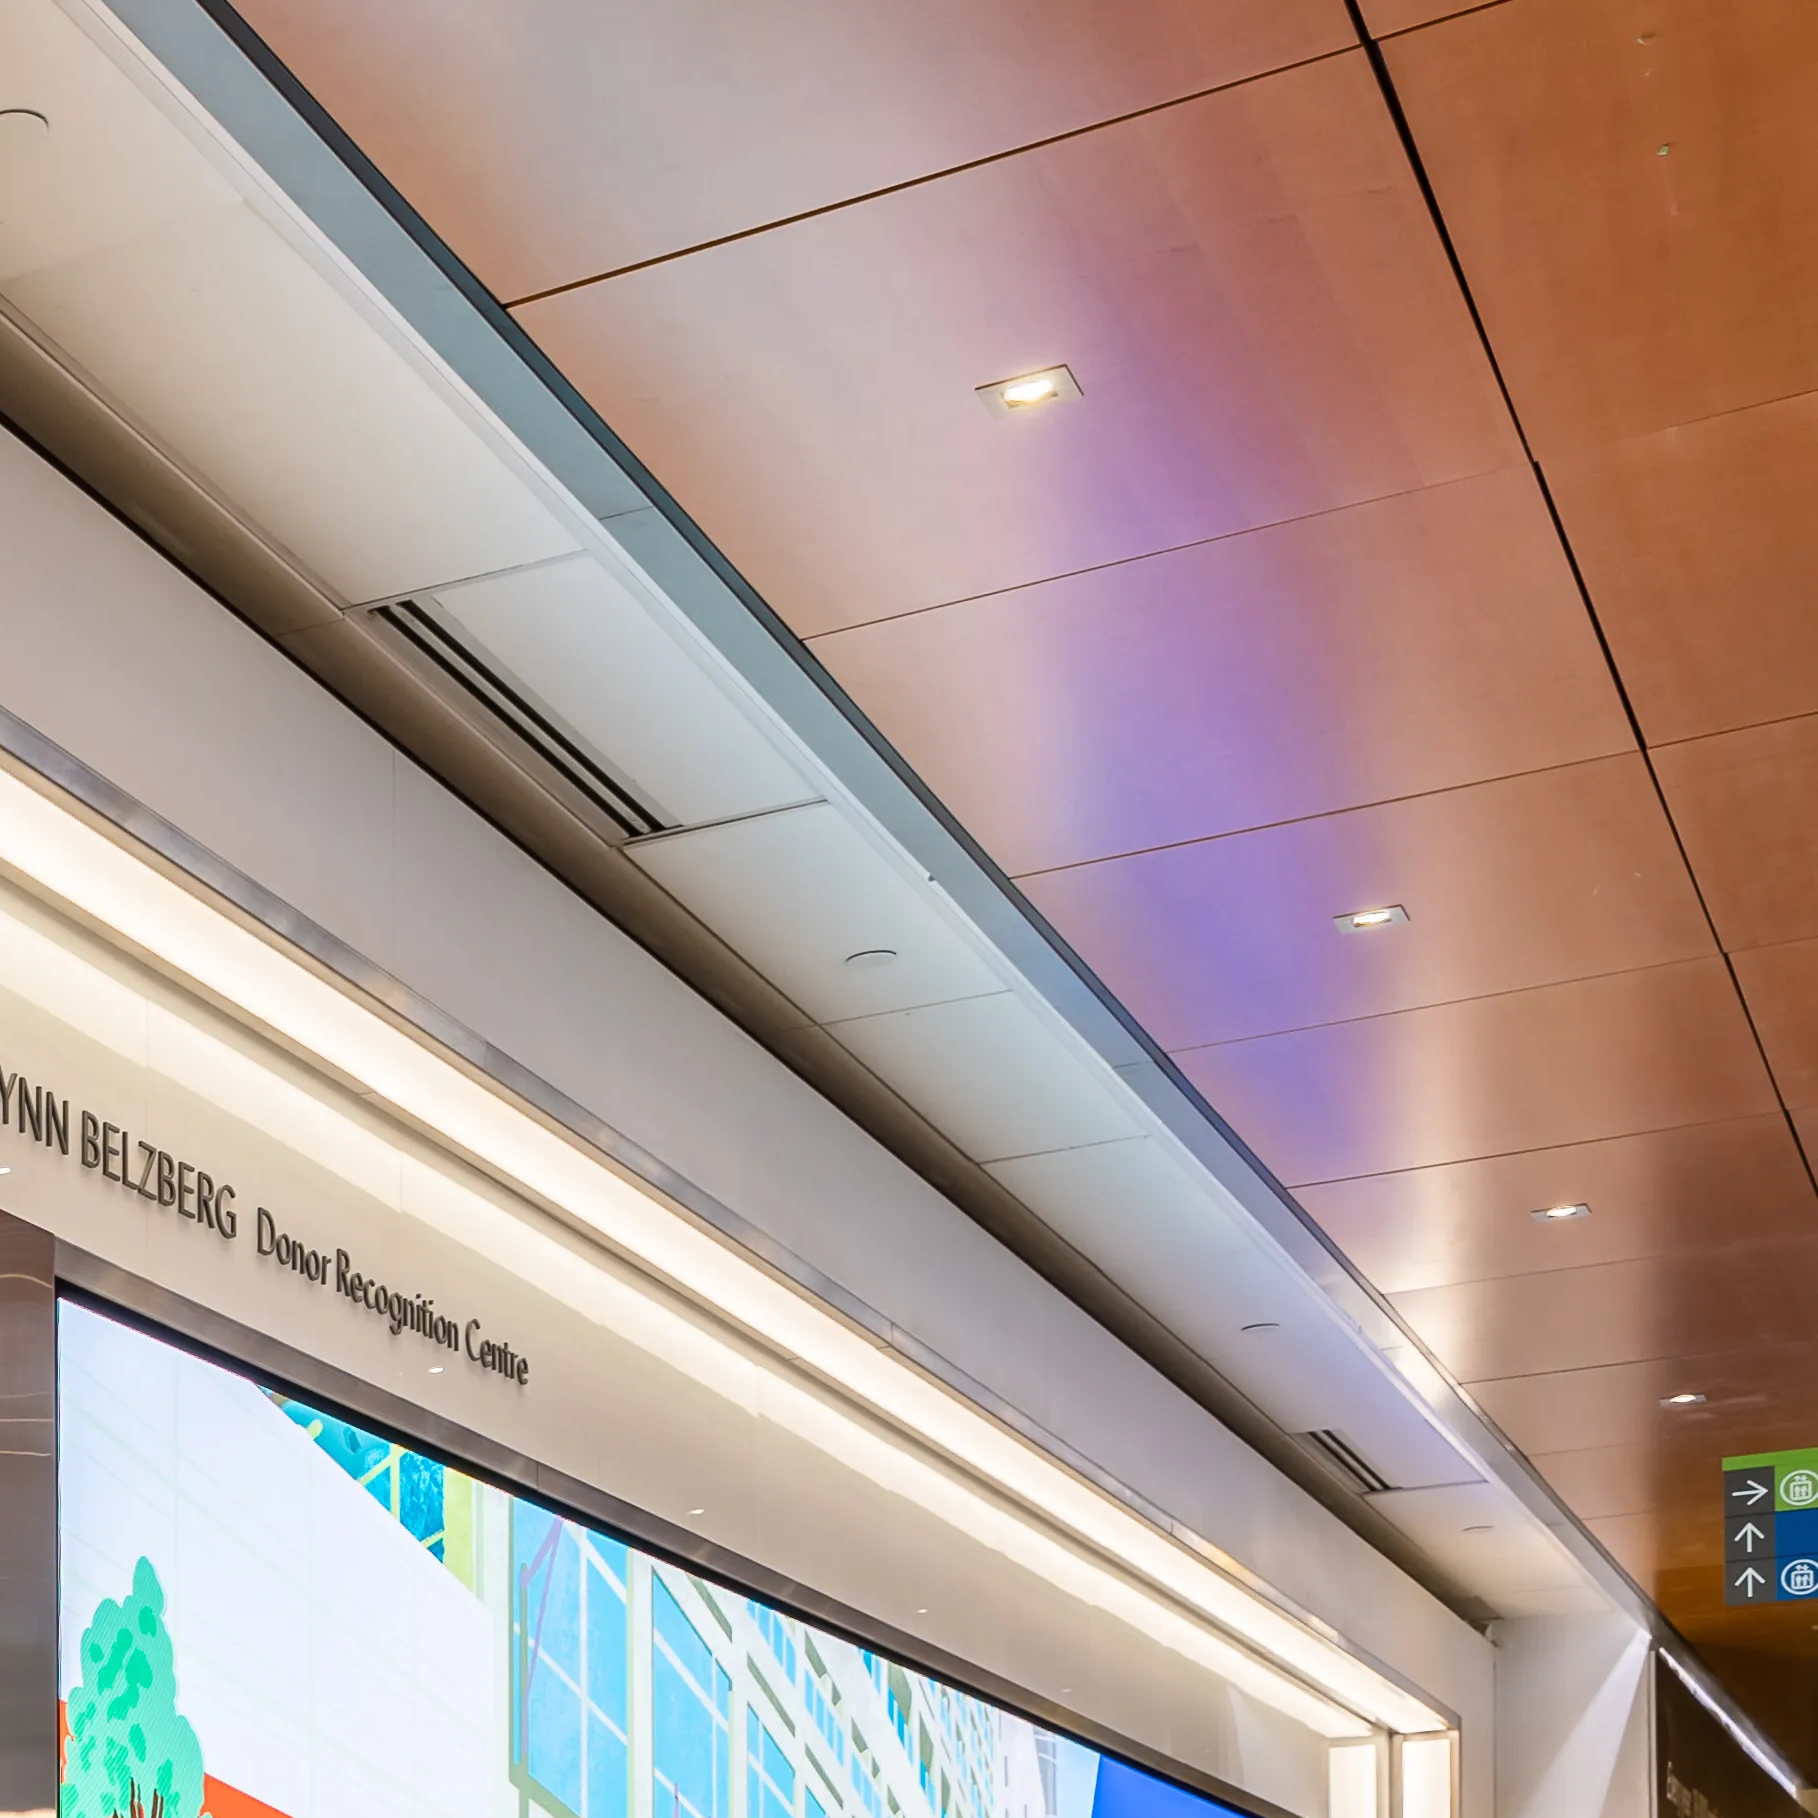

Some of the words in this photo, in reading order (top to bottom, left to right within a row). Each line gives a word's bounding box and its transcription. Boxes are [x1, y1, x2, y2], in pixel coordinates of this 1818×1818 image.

[80, 1108, 238, 1240] BELZBERG
[256, 1206, 332, 1286] Donor
[336, 1247, 460, 1353] Recognition
[464, 1318, 530, 1385] Centre
